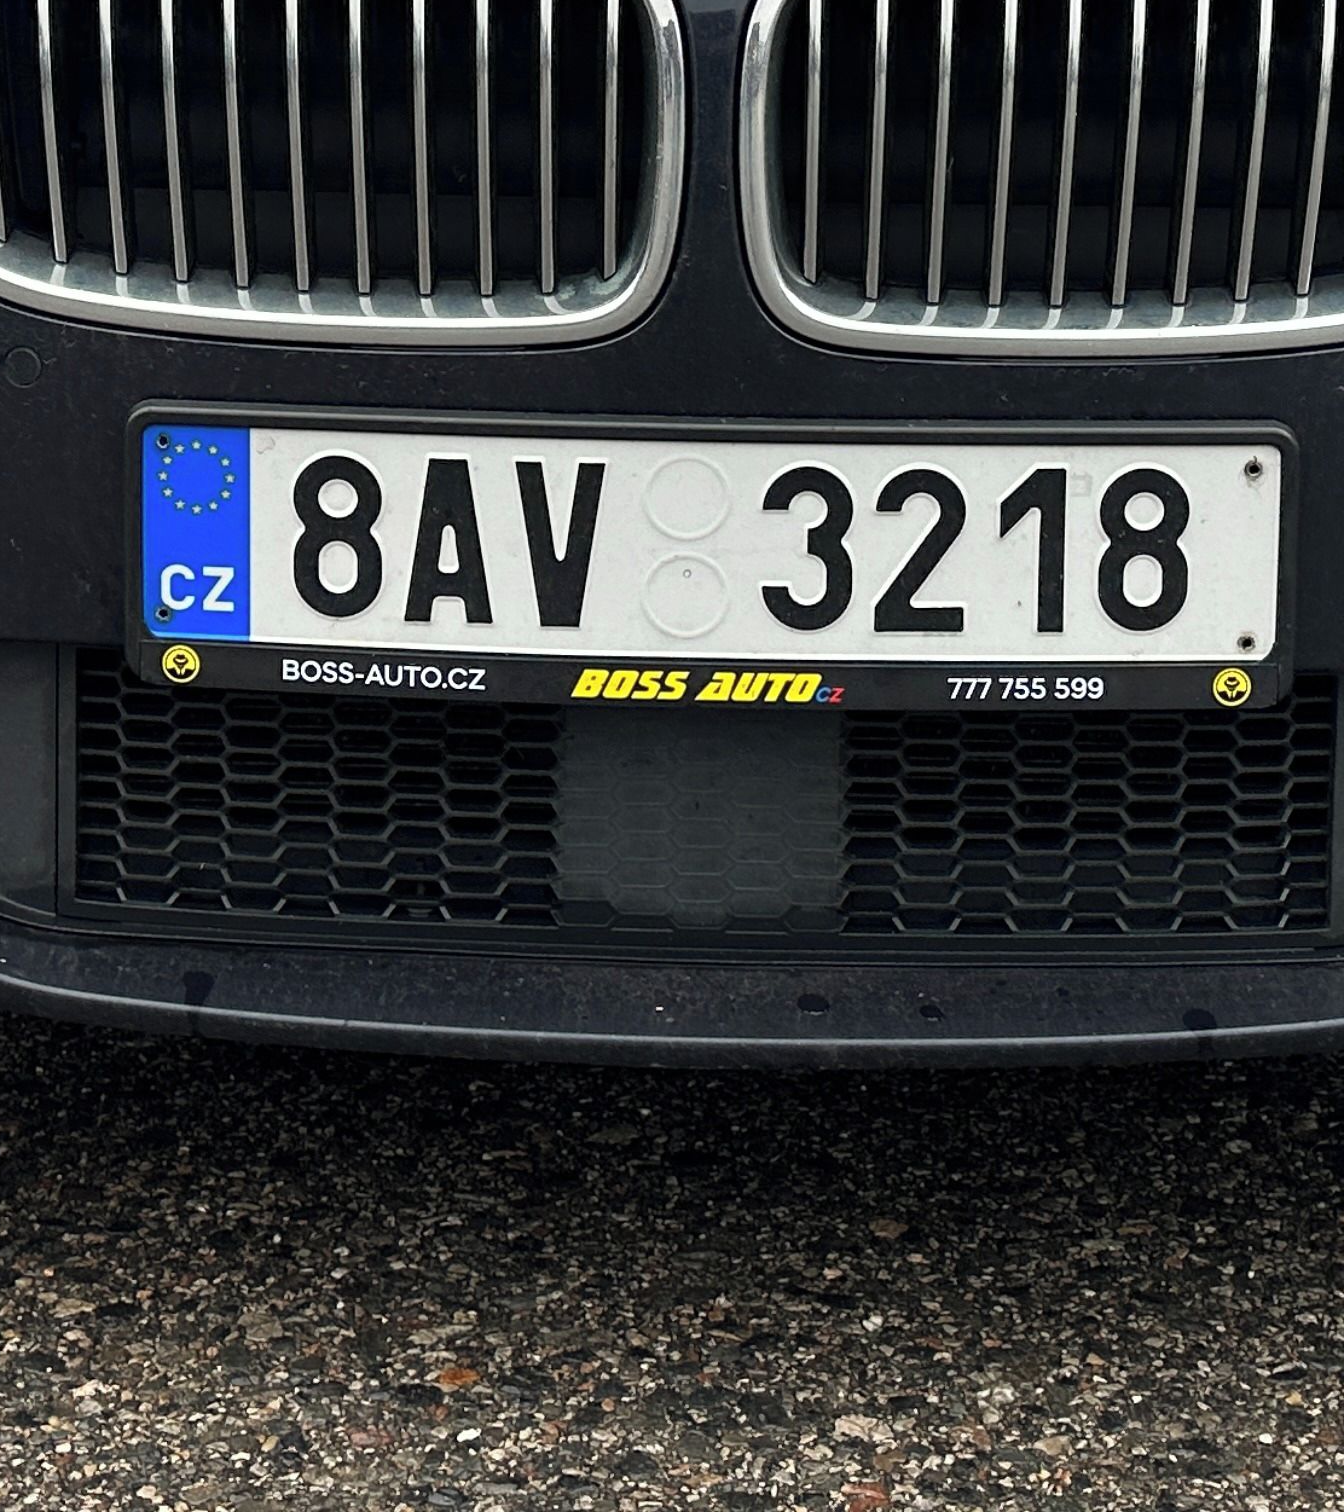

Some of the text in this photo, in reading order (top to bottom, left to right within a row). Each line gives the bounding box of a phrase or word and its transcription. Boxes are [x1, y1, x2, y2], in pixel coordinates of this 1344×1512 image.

[291, 456, 1191, 633] 8AV 3218
[159, 563, 235, 613] CZ
[282, 659, 486, 691] BOSS-AUTO.CZ
[571, 669, 844, 704] BOSS AUTO CZ
[947, 677, 1104, 699] 777 755 599
